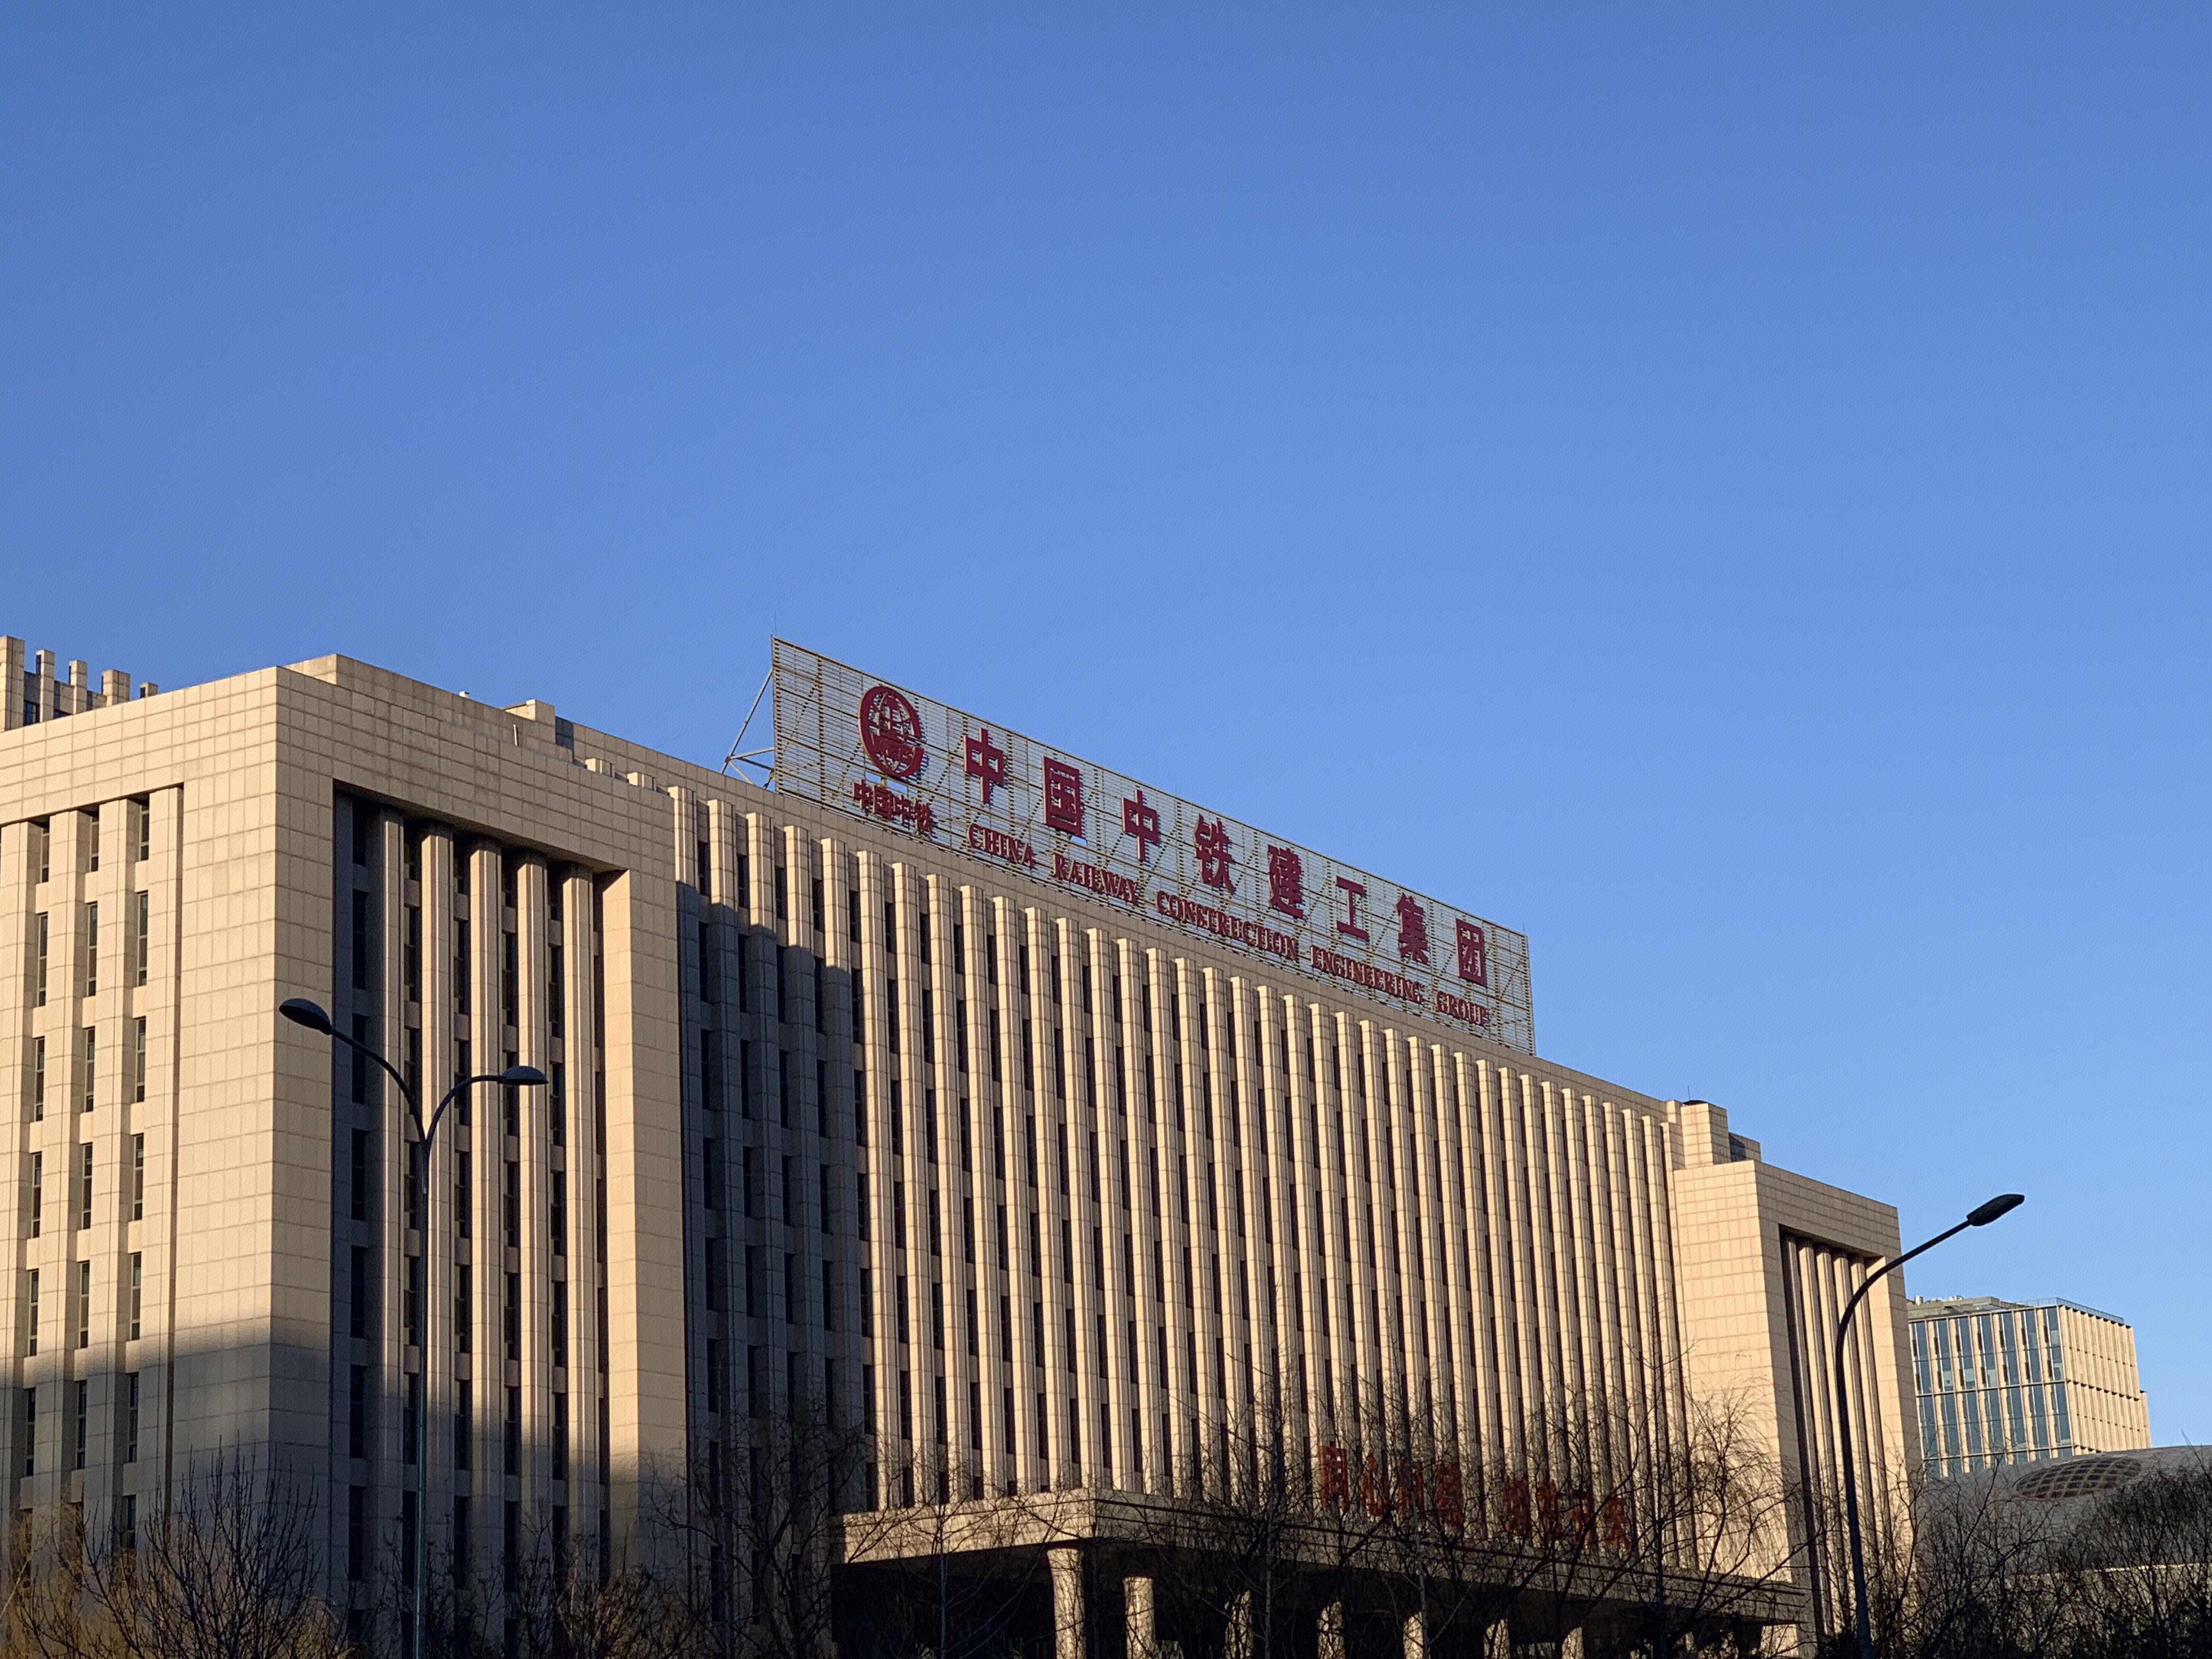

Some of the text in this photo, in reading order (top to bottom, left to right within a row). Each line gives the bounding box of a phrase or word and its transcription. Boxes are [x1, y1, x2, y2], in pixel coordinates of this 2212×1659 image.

[852, 779, 933, 832] 中国中铁
[964, 728, 1486, 987] 中国中铁建工集团
[967, 823, 1488, 1026] CHINA RAILWAY CONSTRUCTION ENGINEERING GROUP
